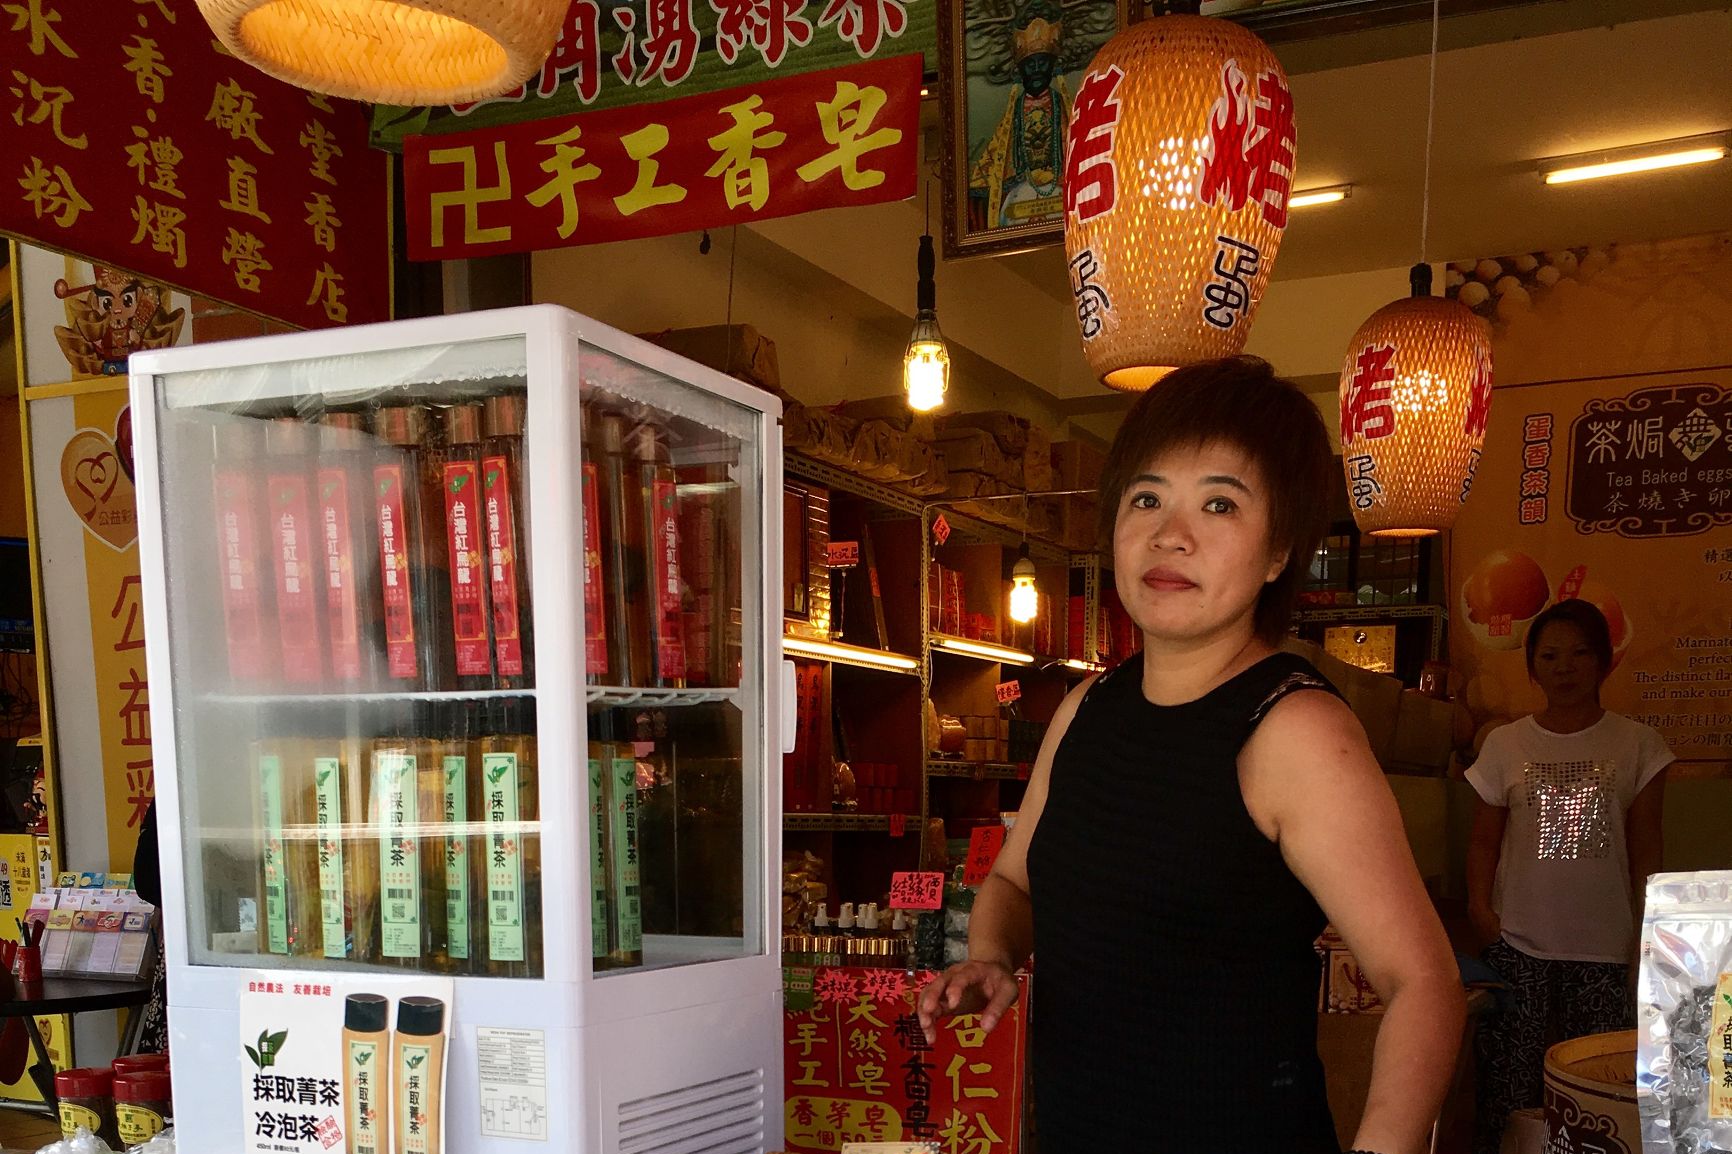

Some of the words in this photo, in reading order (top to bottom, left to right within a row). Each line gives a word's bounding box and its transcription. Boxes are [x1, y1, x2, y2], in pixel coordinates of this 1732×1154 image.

[205, 40, 274, 293] 廠直營
[1521, 414, 1552, 524] 蛋香茶韻
[1607, 471, 1632, 487] Tea
[1641, 468, 1688, 485] Baked
[99, 510, 139, 527] 公益彩
[452, 500, 471, 585] 台灣紅烏龍
[1634, 671, 1658, 684] The
[1661, 670, 1711, 683] distinct
[1642, 690, 1667, 700] and
[1670, 688, 1706, 699] make
[253, 1073, 340, 1107] 採取菁茶
[255, 1110, 319, 1143] 冷泡茶
